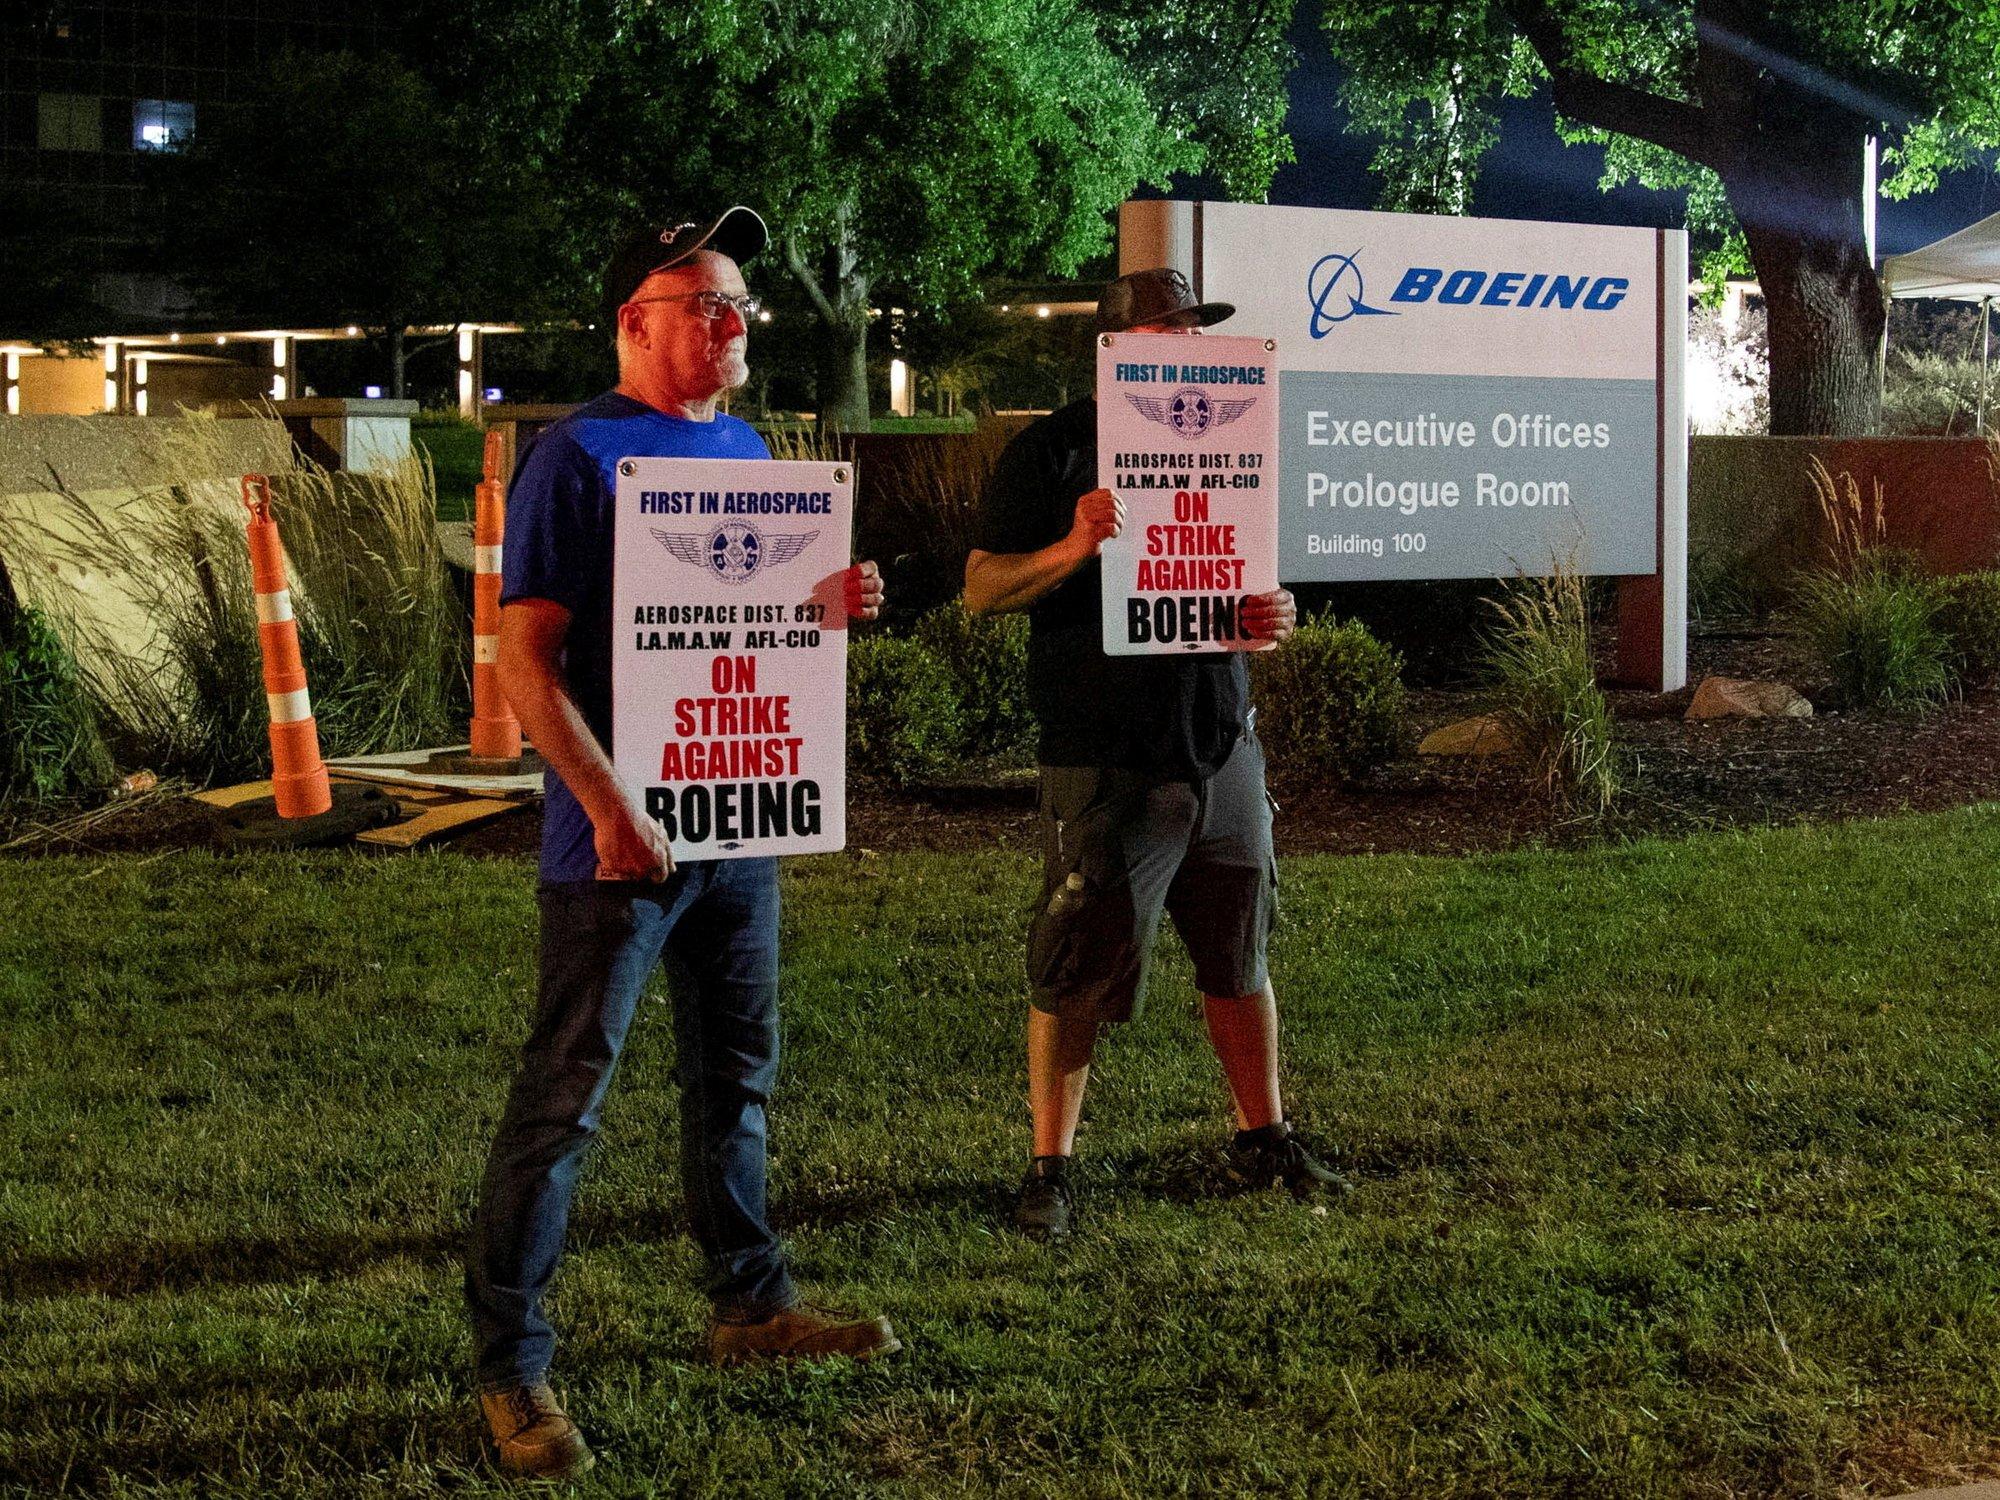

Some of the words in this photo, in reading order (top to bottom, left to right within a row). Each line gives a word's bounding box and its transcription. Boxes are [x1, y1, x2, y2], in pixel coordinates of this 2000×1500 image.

[1390, 268, 1629, 310] BOEING
[1117, 364, 1158, 382] FIRST
[1162, 365, 1177, 383] IN
[1181, 366, 1265, 385] AEROSPACE
[1308, 411, 1475, 447] Executive
[1492, 413, 1610, 448] Offices
[1115, 453, 1194, 468] AEROSPACE
[1199, 454, 1234, 469] DIST.
[1239, 454, 1262, 468] 837
[1117, 474, 1190, 489] I.A.M.A.W
[1201, 474, 1259, 489] AFL-CIO
[1308, 473, 1459, 515] Prologue
[1477, 473, 1569, 506] Room
[641, 492, 694, 514] FIRST
[700, 492, 718, 513] IN
[724, 492, 831, 514] AEROSPACE
[1175, 492, 1208, 522] ON
[1147, 525, 1235, 556] STRIKE
[1308, 535, 1383, 557] Building
[1392, 533, 1426, 552] 100
[1138, 559, 1245, 590] AGAINST
[635, 606, 736, 624] AEROSPACE
[744, 605, 787, 623] DIST.
[795, 604, 826, 623] 837
[637, 632, 731, 650] I.A.M.A.W
[745, 630, 820, 649] AFL-CIO
[712, 656, 755, 694] ON
[675, 696, 790, 738] STRIKE
[662, 741, 803, 781] AGAINST
[646, 780, 821, 844] BOEING
